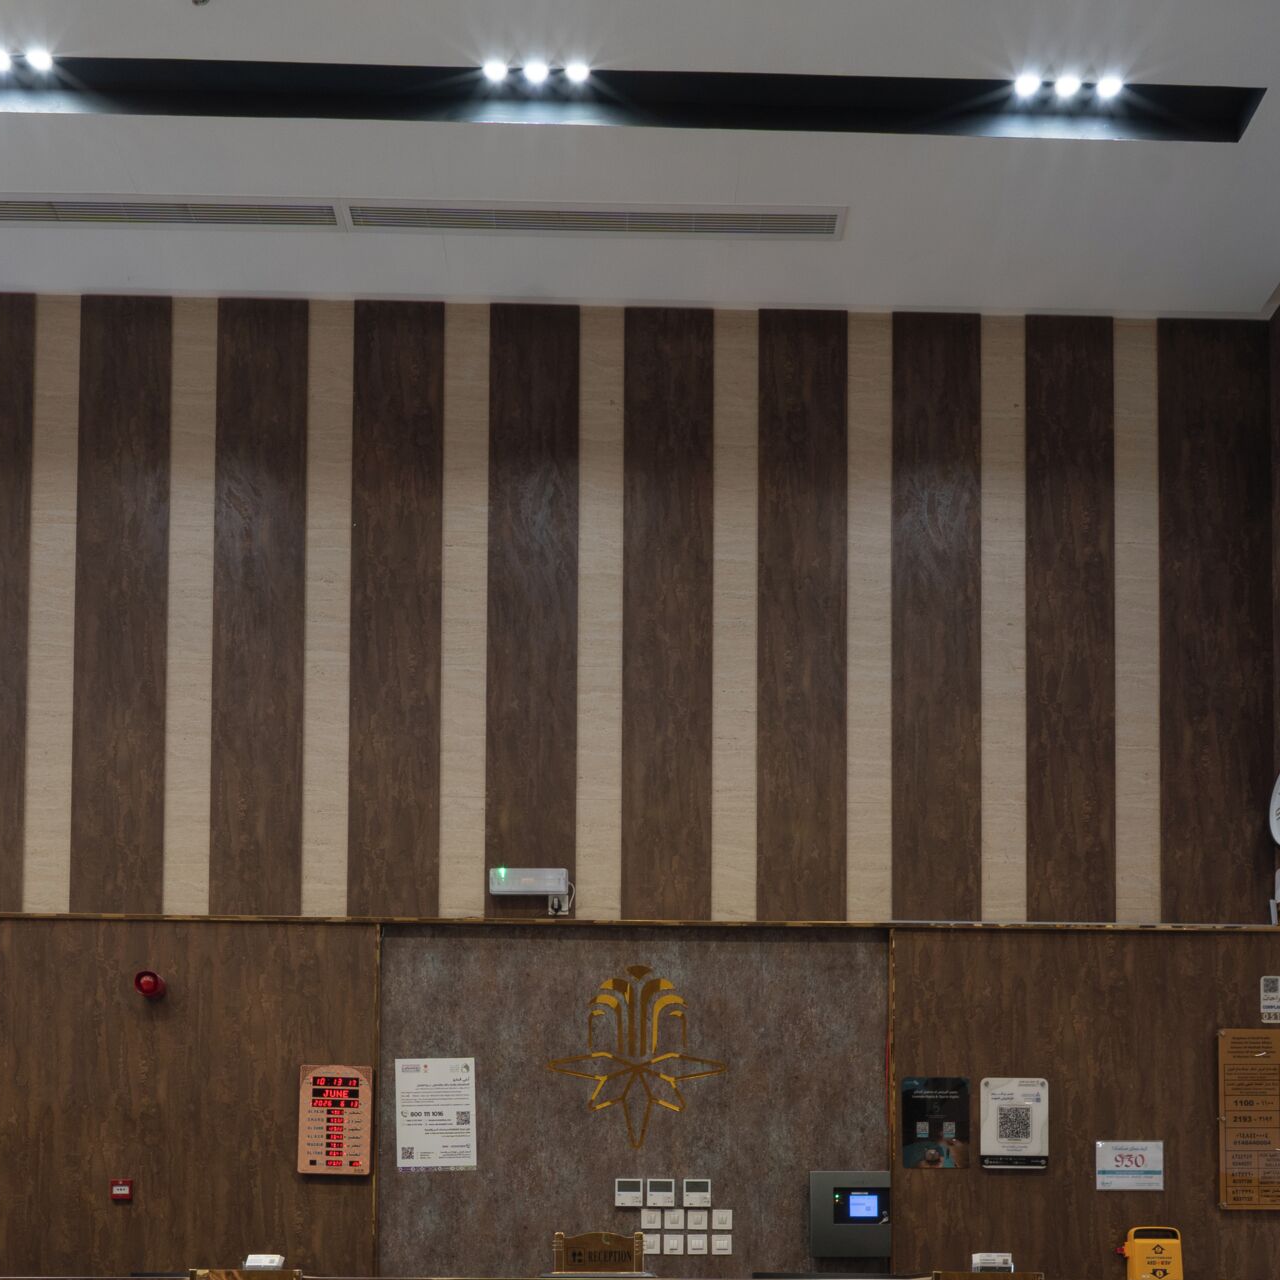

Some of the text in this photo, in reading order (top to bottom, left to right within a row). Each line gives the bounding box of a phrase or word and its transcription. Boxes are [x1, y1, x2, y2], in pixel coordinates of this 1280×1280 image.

[323, 1090, 349, 1098] JUNE
[1114, 1153, 1145, 1168] 930
[588, 1250, 632, 1263] RECEPTION
